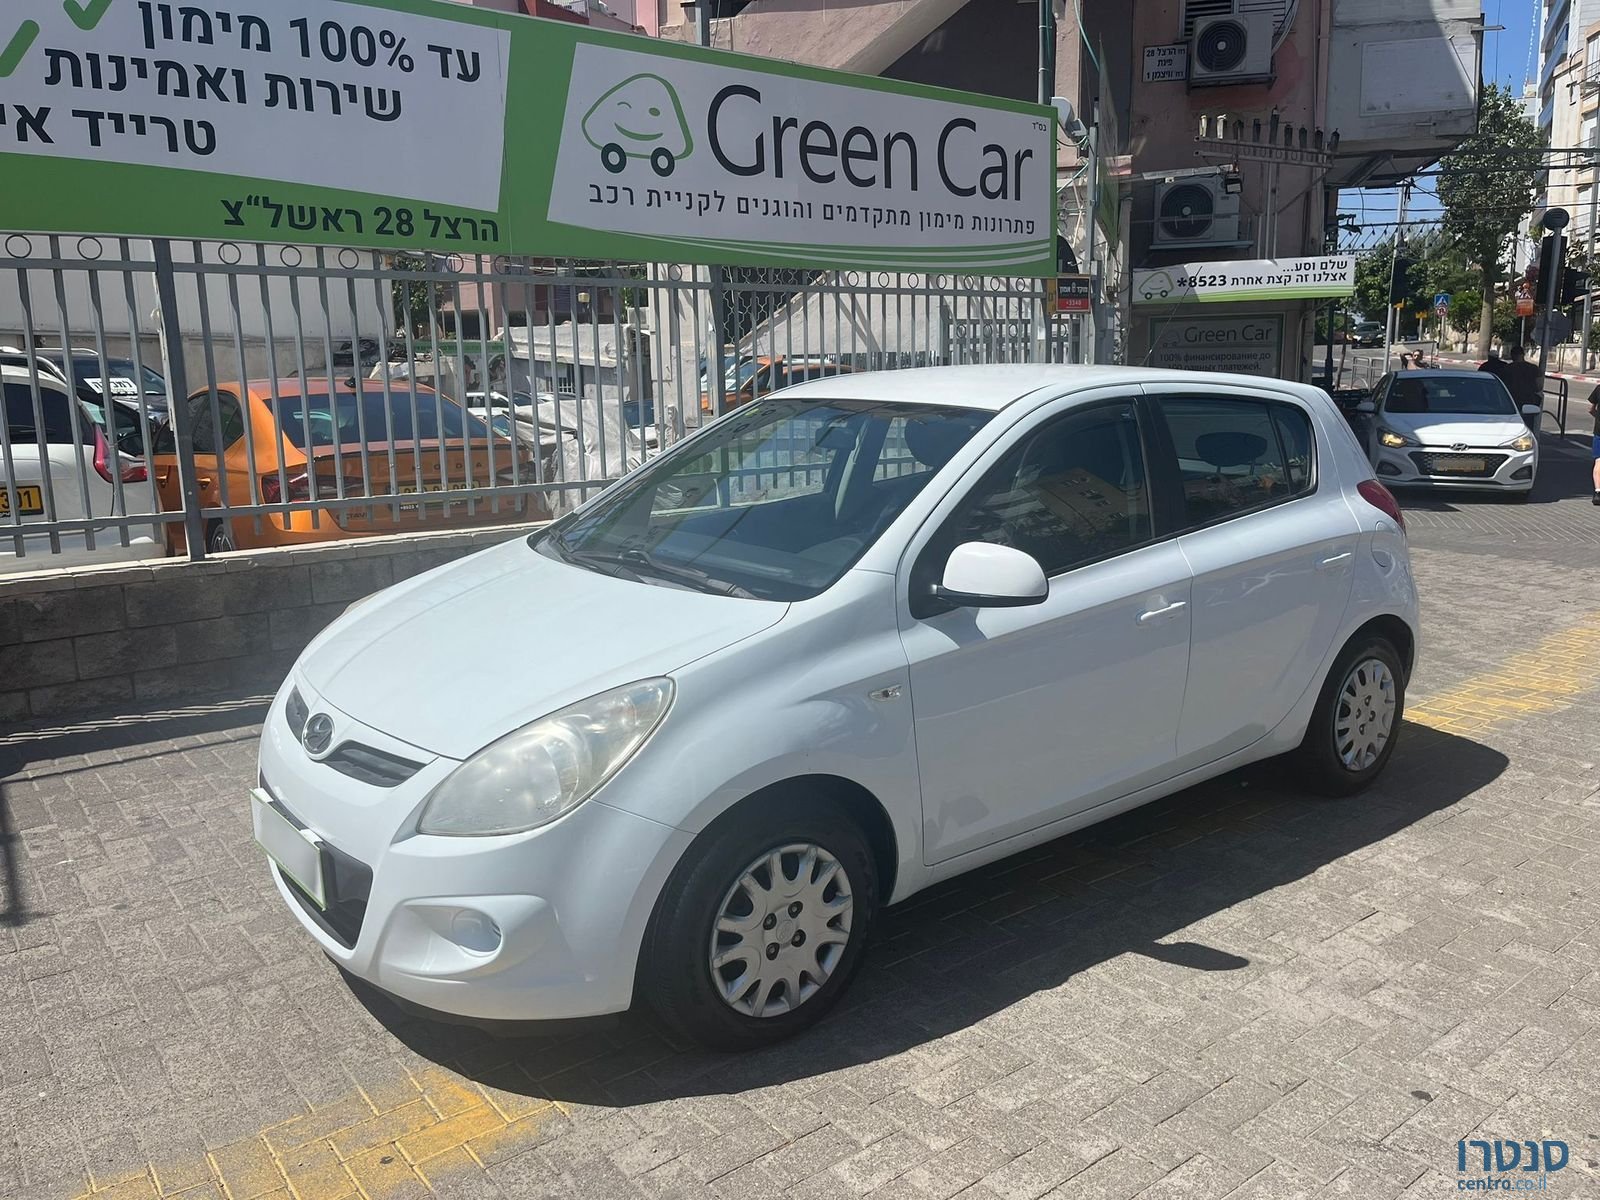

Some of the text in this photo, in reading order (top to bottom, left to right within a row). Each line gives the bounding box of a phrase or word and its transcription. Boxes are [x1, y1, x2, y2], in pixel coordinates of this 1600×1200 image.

[138, 1, 481, 83] עד 100% מימון
[1157, 47, 1176, 56] הרצל
[44, 47, 402, 122] שירות ואמינות
[0, 103, 216, 156] טרייד אי
[707, 85, 1033, 201] Green Car
[589, 182, 1036, 235] פתרונות מימון מתקדמים והוגנים לקניית רכב
[374, 206, 414, 237] 28
[424, 209, 499, 242] הרצל
[1283, 259, 1348, 272] שלם וסע...
[1230, 275, 1263, 286] אחרת
[1266, 274, 1292, 286] קצת
[1296, 272, 1310, 283] זה
[1313, 271, 1347, 282] אצלנו
[1184, 324, 1272, 343] Green Car
[1160, 352, 1271, 363] 100% финансирование до
